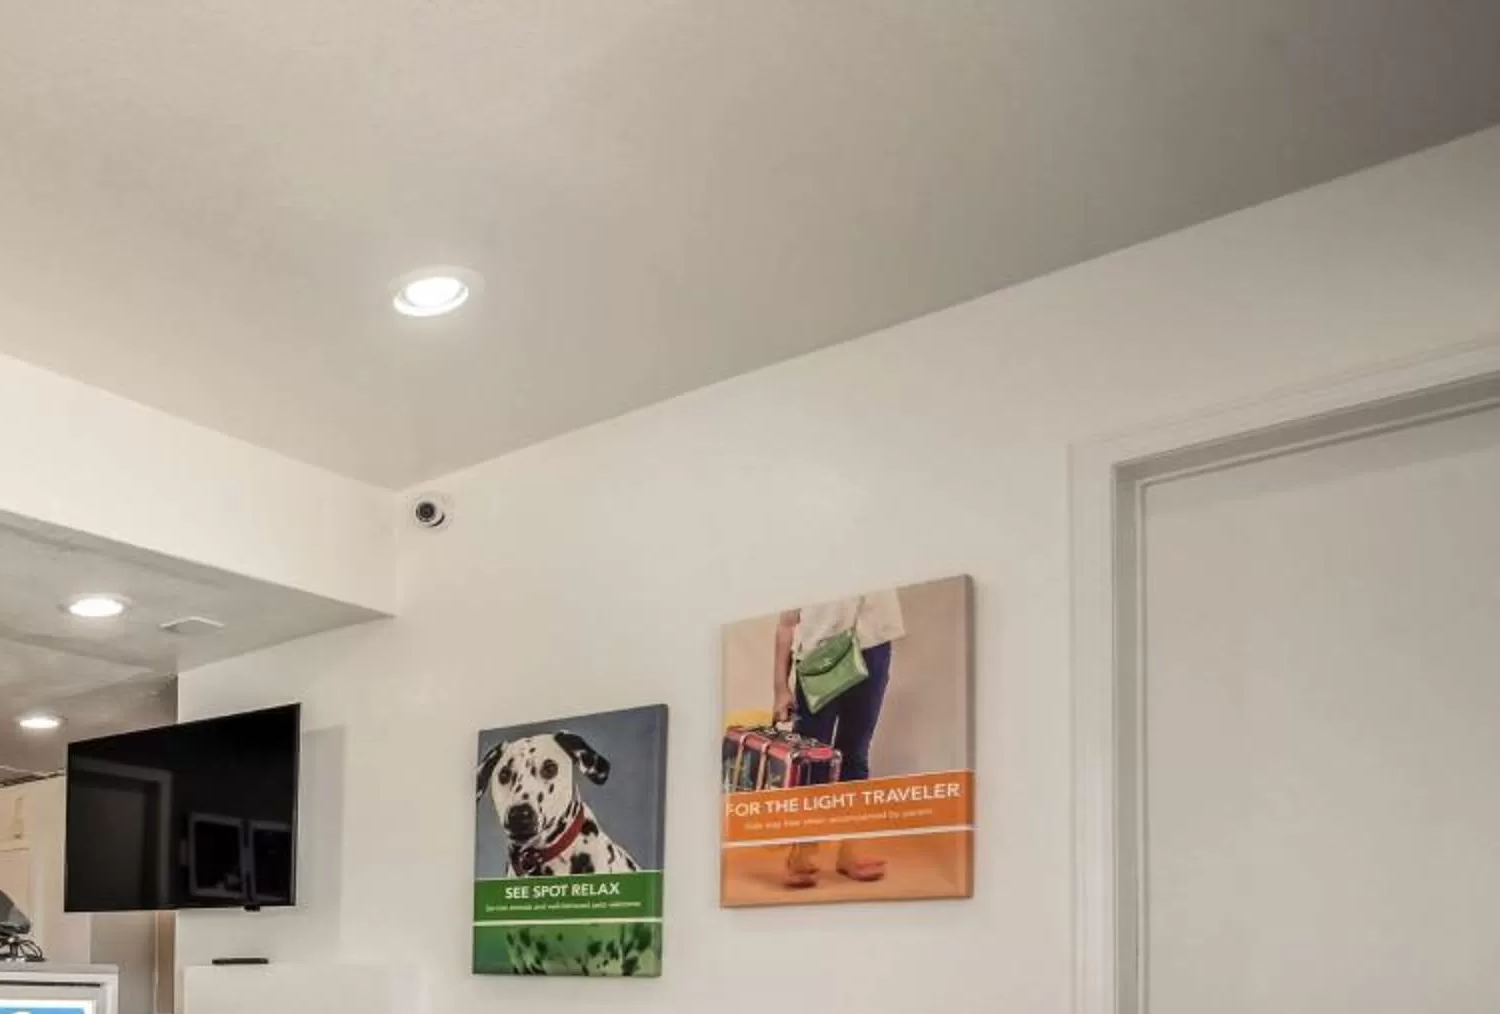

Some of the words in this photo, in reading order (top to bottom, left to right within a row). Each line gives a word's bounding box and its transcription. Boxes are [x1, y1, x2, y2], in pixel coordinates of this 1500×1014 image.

[727, 802, 761, 816] FOR
[765, 801, 800, 814] THE
[803, 793, 855, 810] LIGHT
[862, 783, 961, 804] TRAVELER
[505, 886, 529, 899] SEE
[533, 884, 568, 898] SPOT
[571, 881, 620, 897] RELAX
